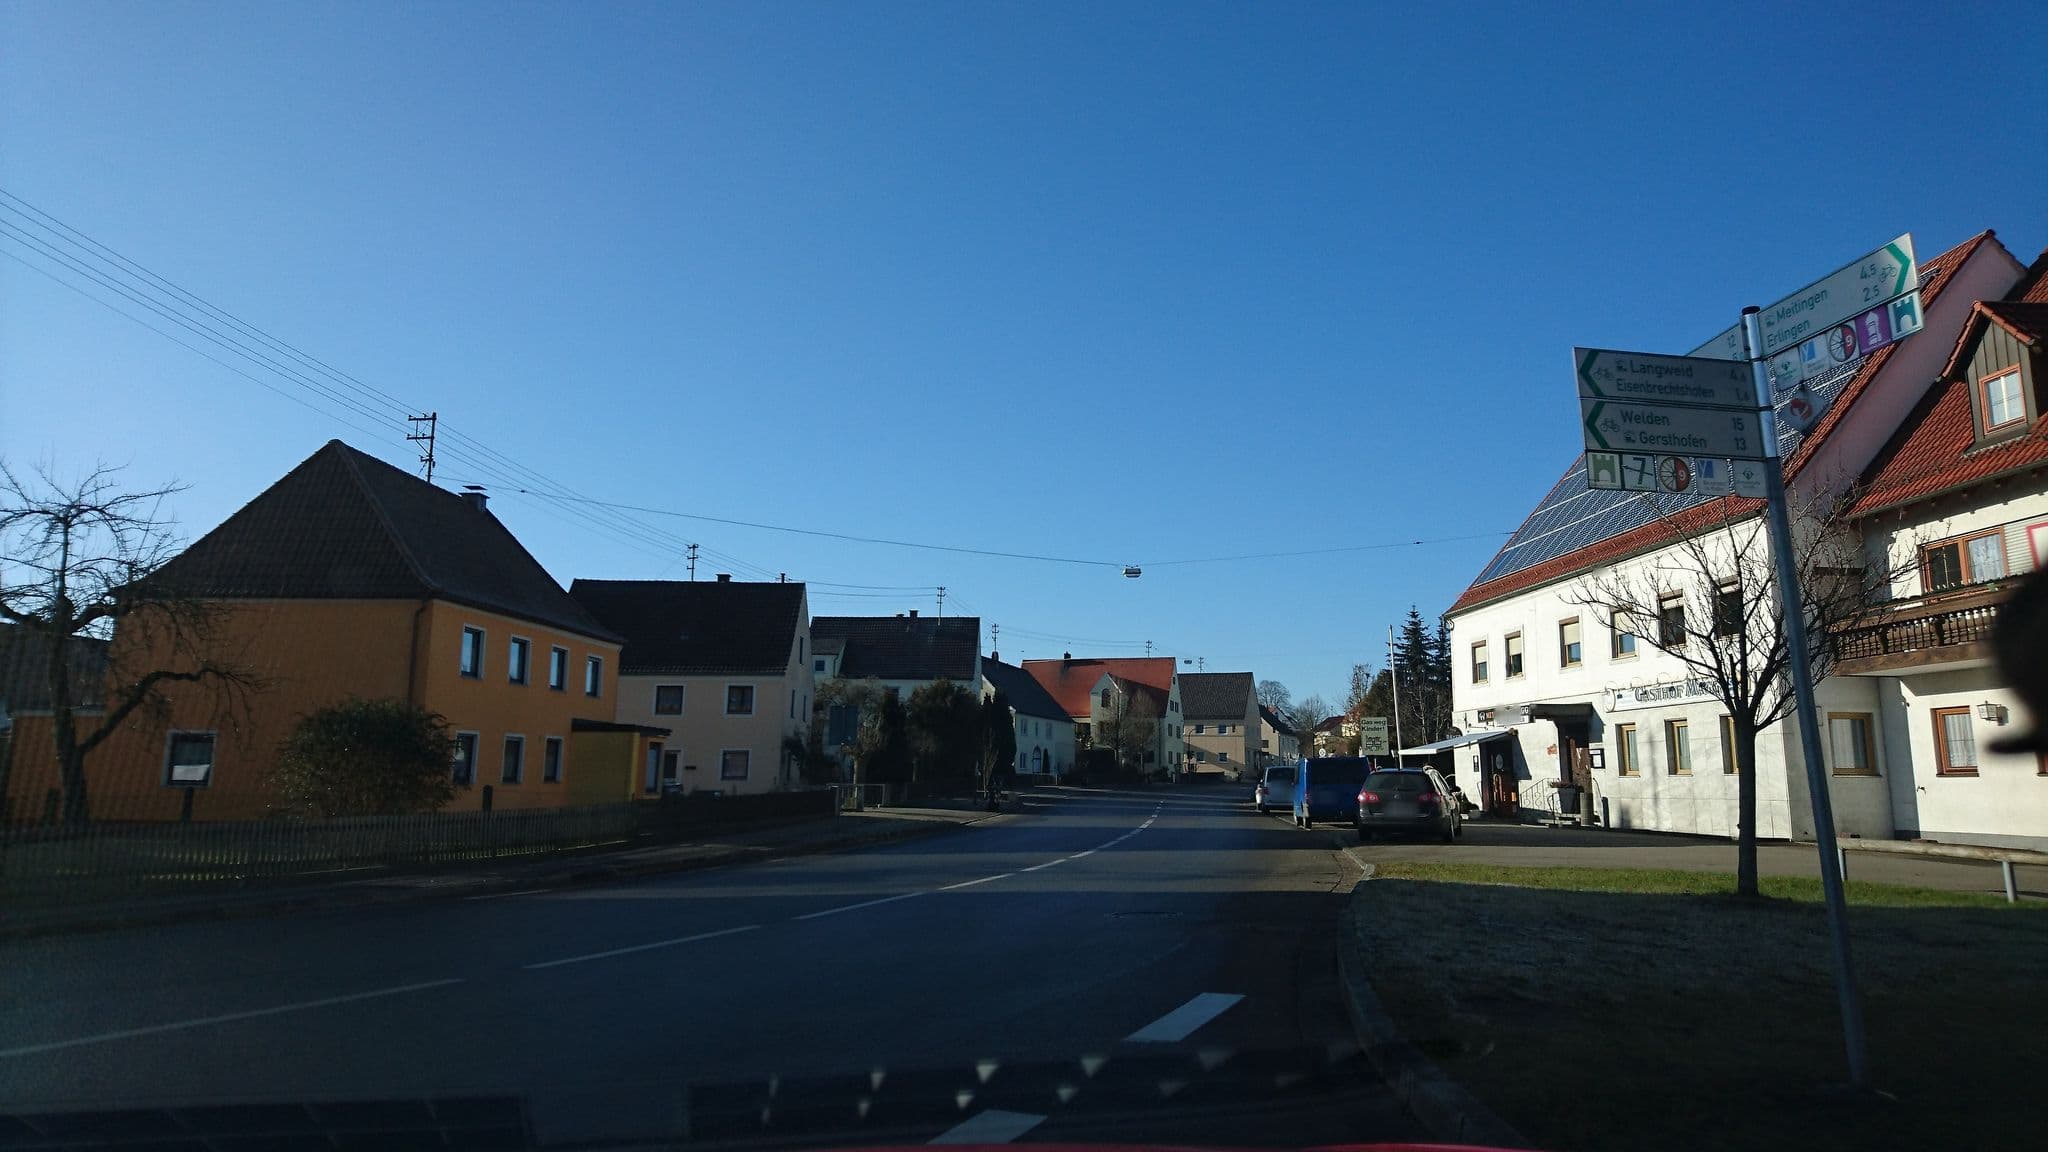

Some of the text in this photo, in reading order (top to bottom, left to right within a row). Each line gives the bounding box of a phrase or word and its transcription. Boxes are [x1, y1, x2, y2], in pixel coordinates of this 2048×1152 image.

[1775, 289, 1828, 321] Meitingen
[1767, 319, 1810, 348] Erlingen
[1630, 360, 1693, 378] Langweid
[1616, 378, 1714, 398] Eisenbrechtshofen
[1620, 409, 1670, 426] Welden
[1732, 417, 1745, 431] 15
[1639, 431, 1707, 449] Gersthofen
[1733, 437, 1747, 450] 13
